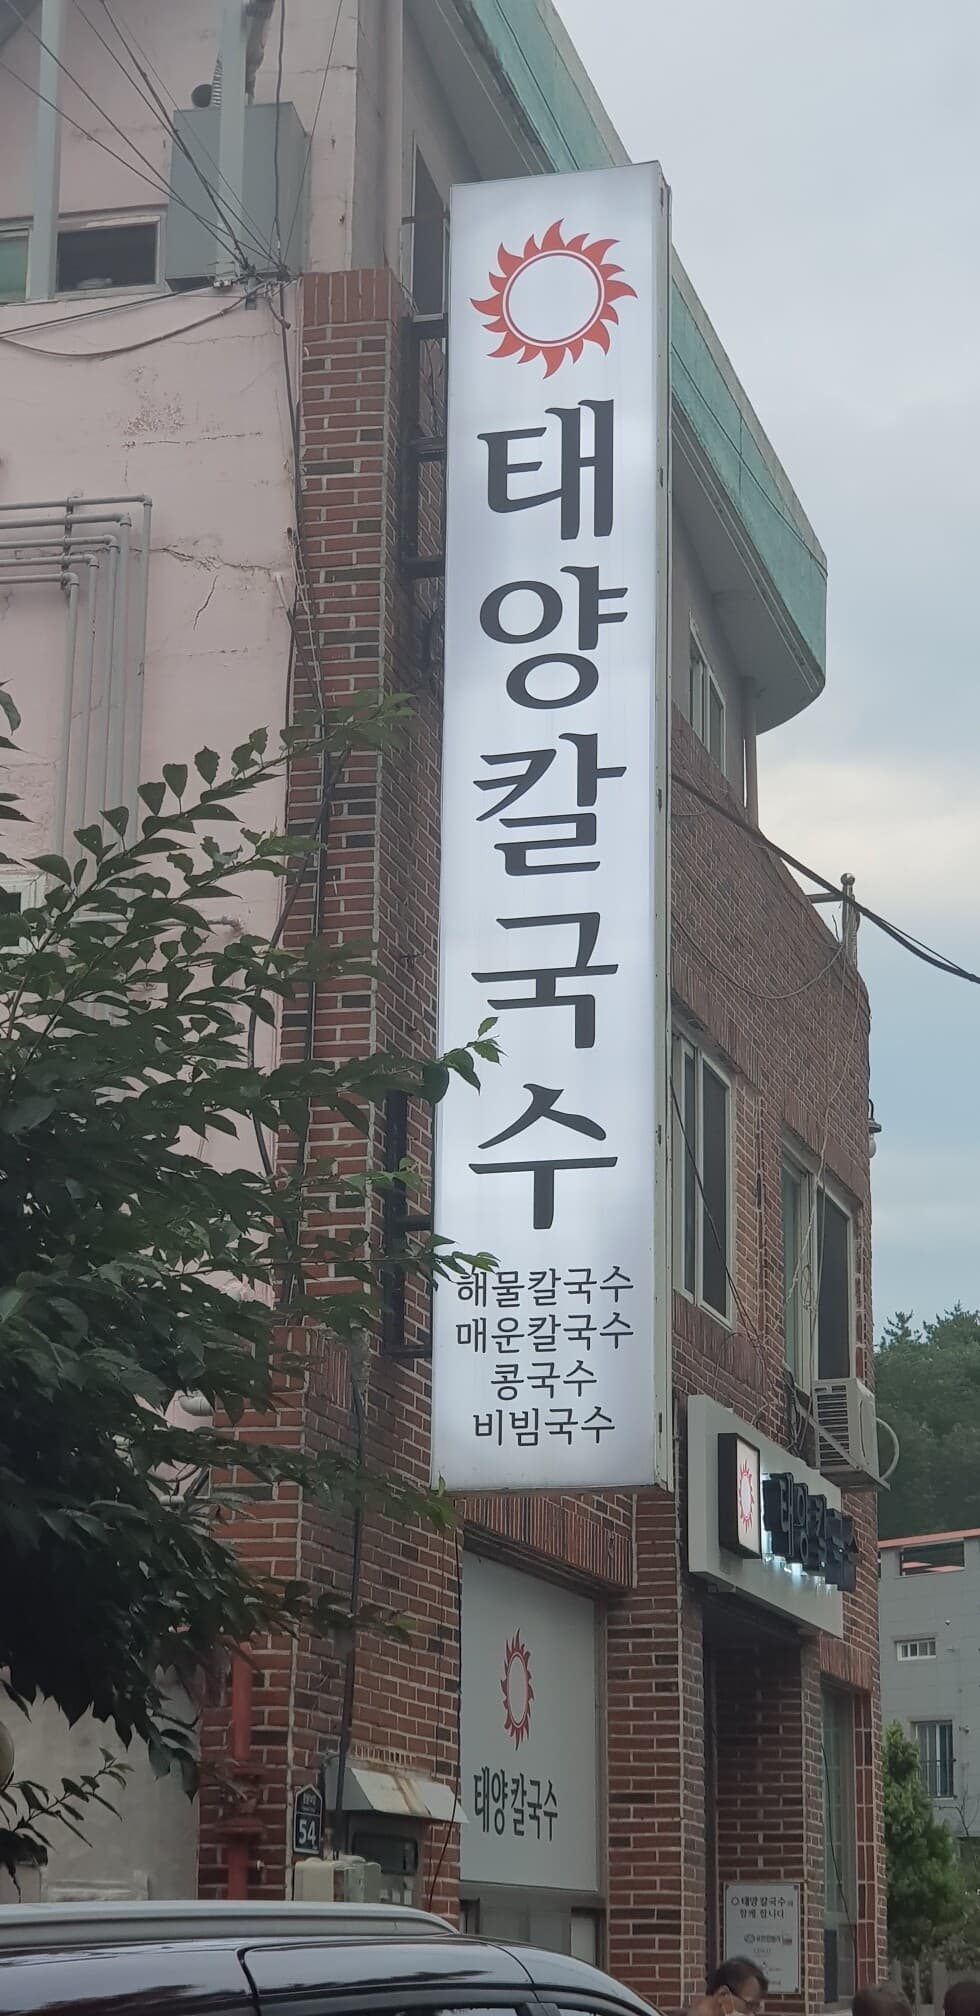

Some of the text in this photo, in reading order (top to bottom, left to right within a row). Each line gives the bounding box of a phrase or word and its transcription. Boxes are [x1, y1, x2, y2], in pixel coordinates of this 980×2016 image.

[468, 399, 628, 1230] 태양칼국수
[456, 1266, 633, 1307] 해물칼국수
[456, 1312, 633, 1353] 매운칼국수
[491, 1360, 597, 1400] 콩국수
[473, 1406, 615, 1446] 비빔국수
[474, 1766, 558, 1841] 태양칼국수
[298, 1819, 316, 1845] 54
